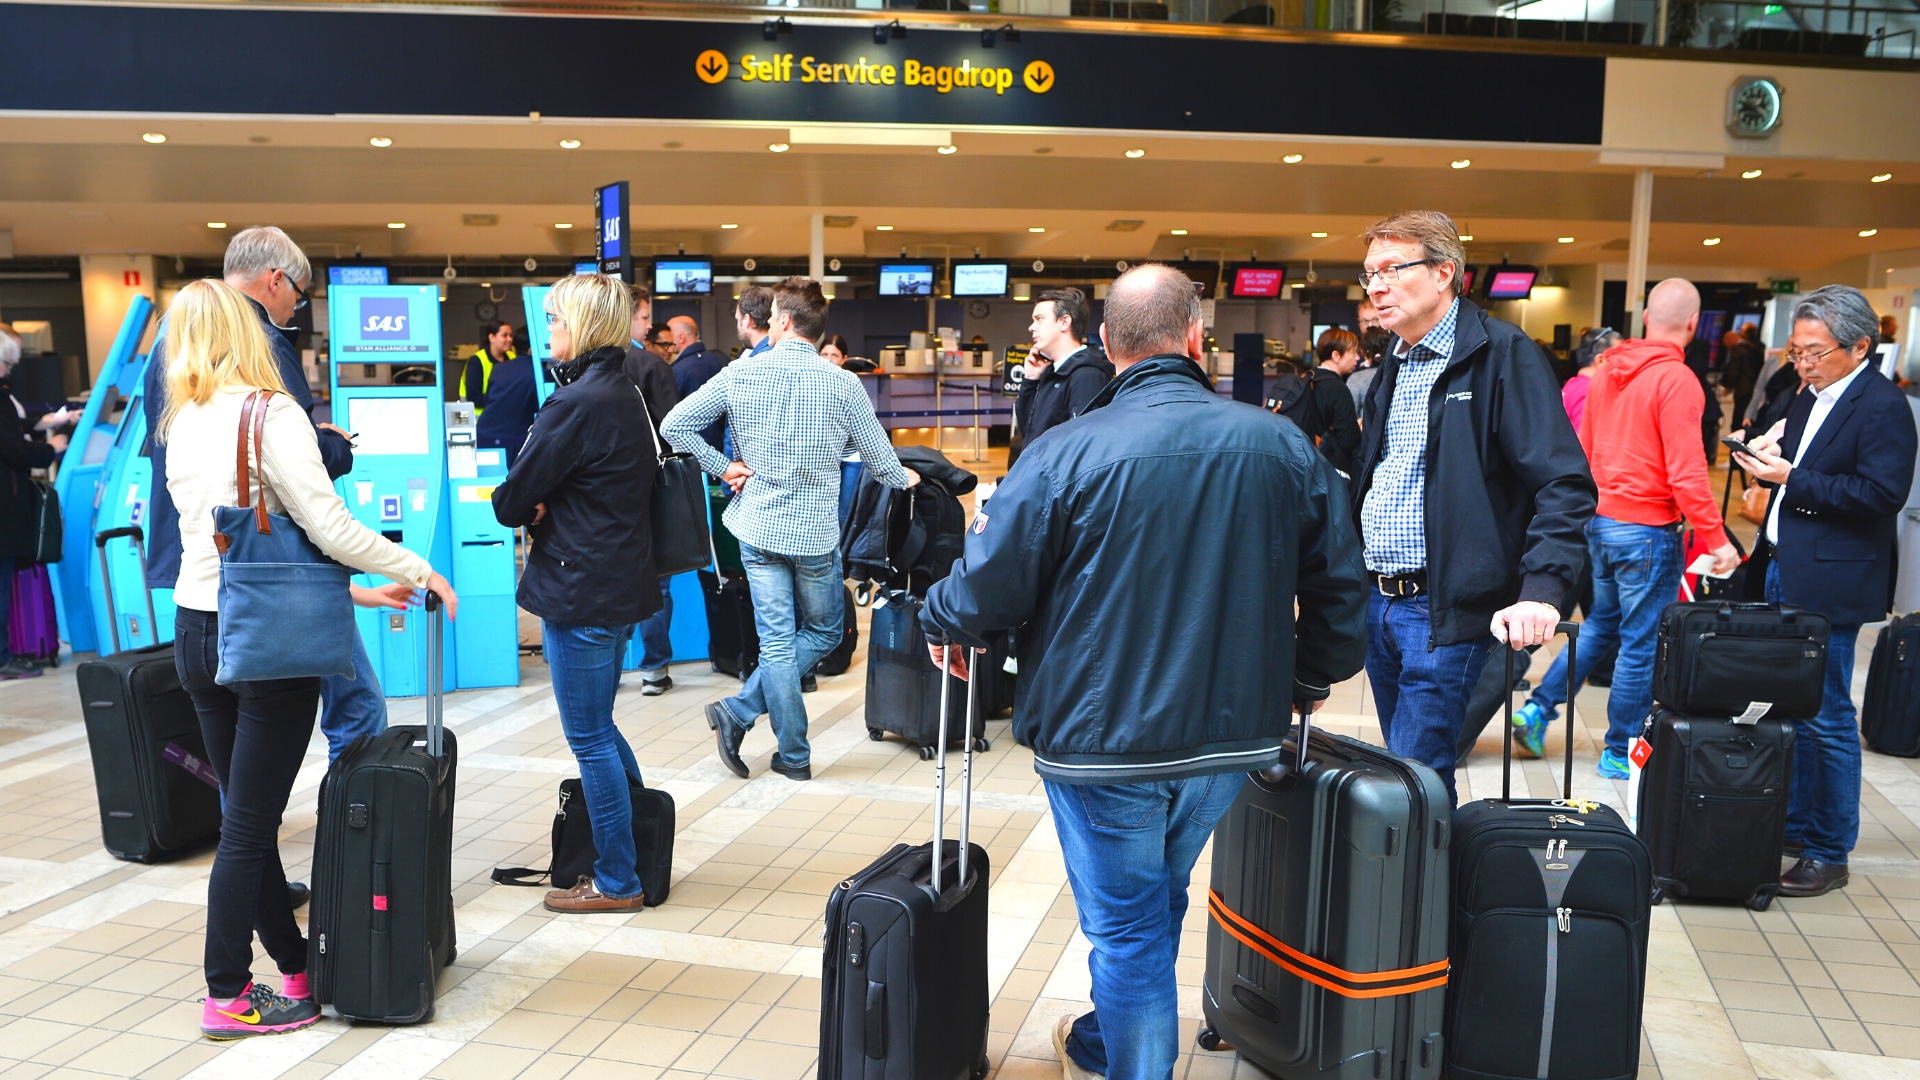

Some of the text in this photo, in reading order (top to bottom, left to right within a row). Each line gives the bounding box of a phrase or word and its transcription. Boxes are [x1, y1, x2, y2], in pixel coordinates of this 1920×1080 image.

[741, 53, 1013, 94] Self Service Bagdrop
[603, 216, 620, 243] SAS
[342, 276, 385, 284] SUPPORT
[363, 315, 407, 332] SAS
